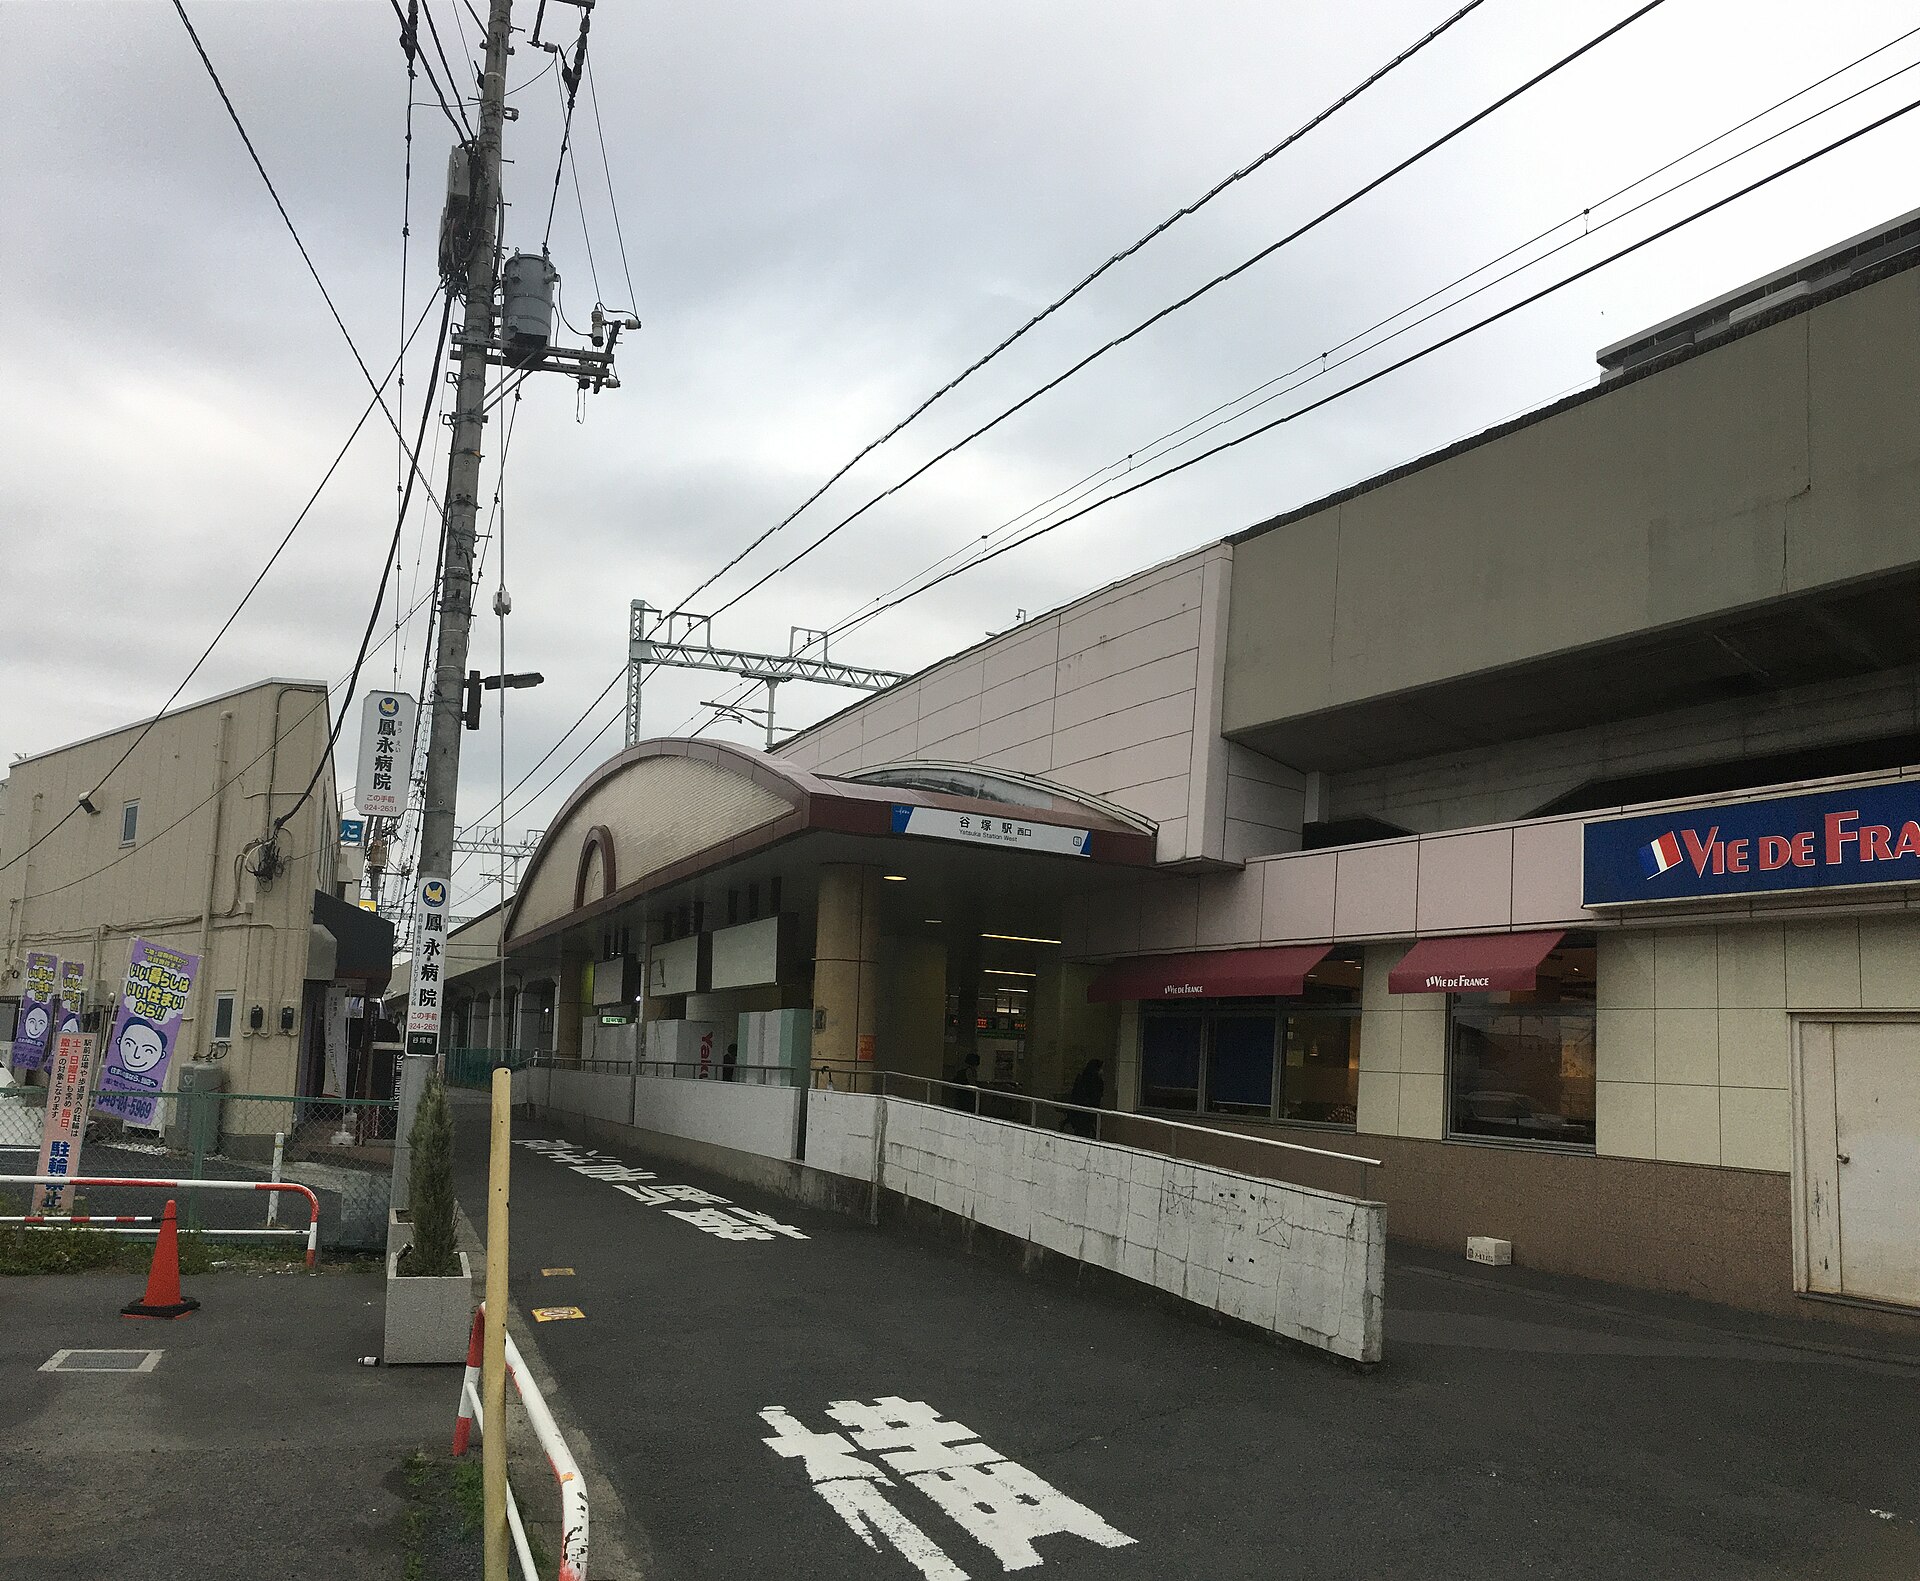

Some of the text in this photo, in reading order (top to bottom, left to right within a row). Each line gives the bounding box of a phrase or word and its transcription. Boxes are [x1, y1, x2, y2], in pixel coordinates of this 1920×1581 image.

[373, 718, 396, 791] 鳳永病院
[366, 794, 395, 804] この手前
[364, 803, 397, 812] 924-2631
[959, 829, 981, 838] Yatsuka
[982, 831, 1003, 841] Station
[1017, 827, 1032, 837] 西口
[1680, 826, 1750, 878] VIE
[1758, 831, 1816, 871] DE
[419, 912, 443, 1007] 鳳永病院
[129, 962, 191, 993] いい暮らしは
[1434, 975, 1489, 987] VIE DE FRANCE
[126, 981, 185, 1010] いい住まい
[411, 1012, 438, 1021] この手前
[409, 1022, 438, 1031] 924-2631
[412, 1036, 433, 1045] 谷塚町
[71, 1039, 92, 1137] 駅前広場や歩道等への駐輪は
[757, 1395, 1139, 1581] 横
